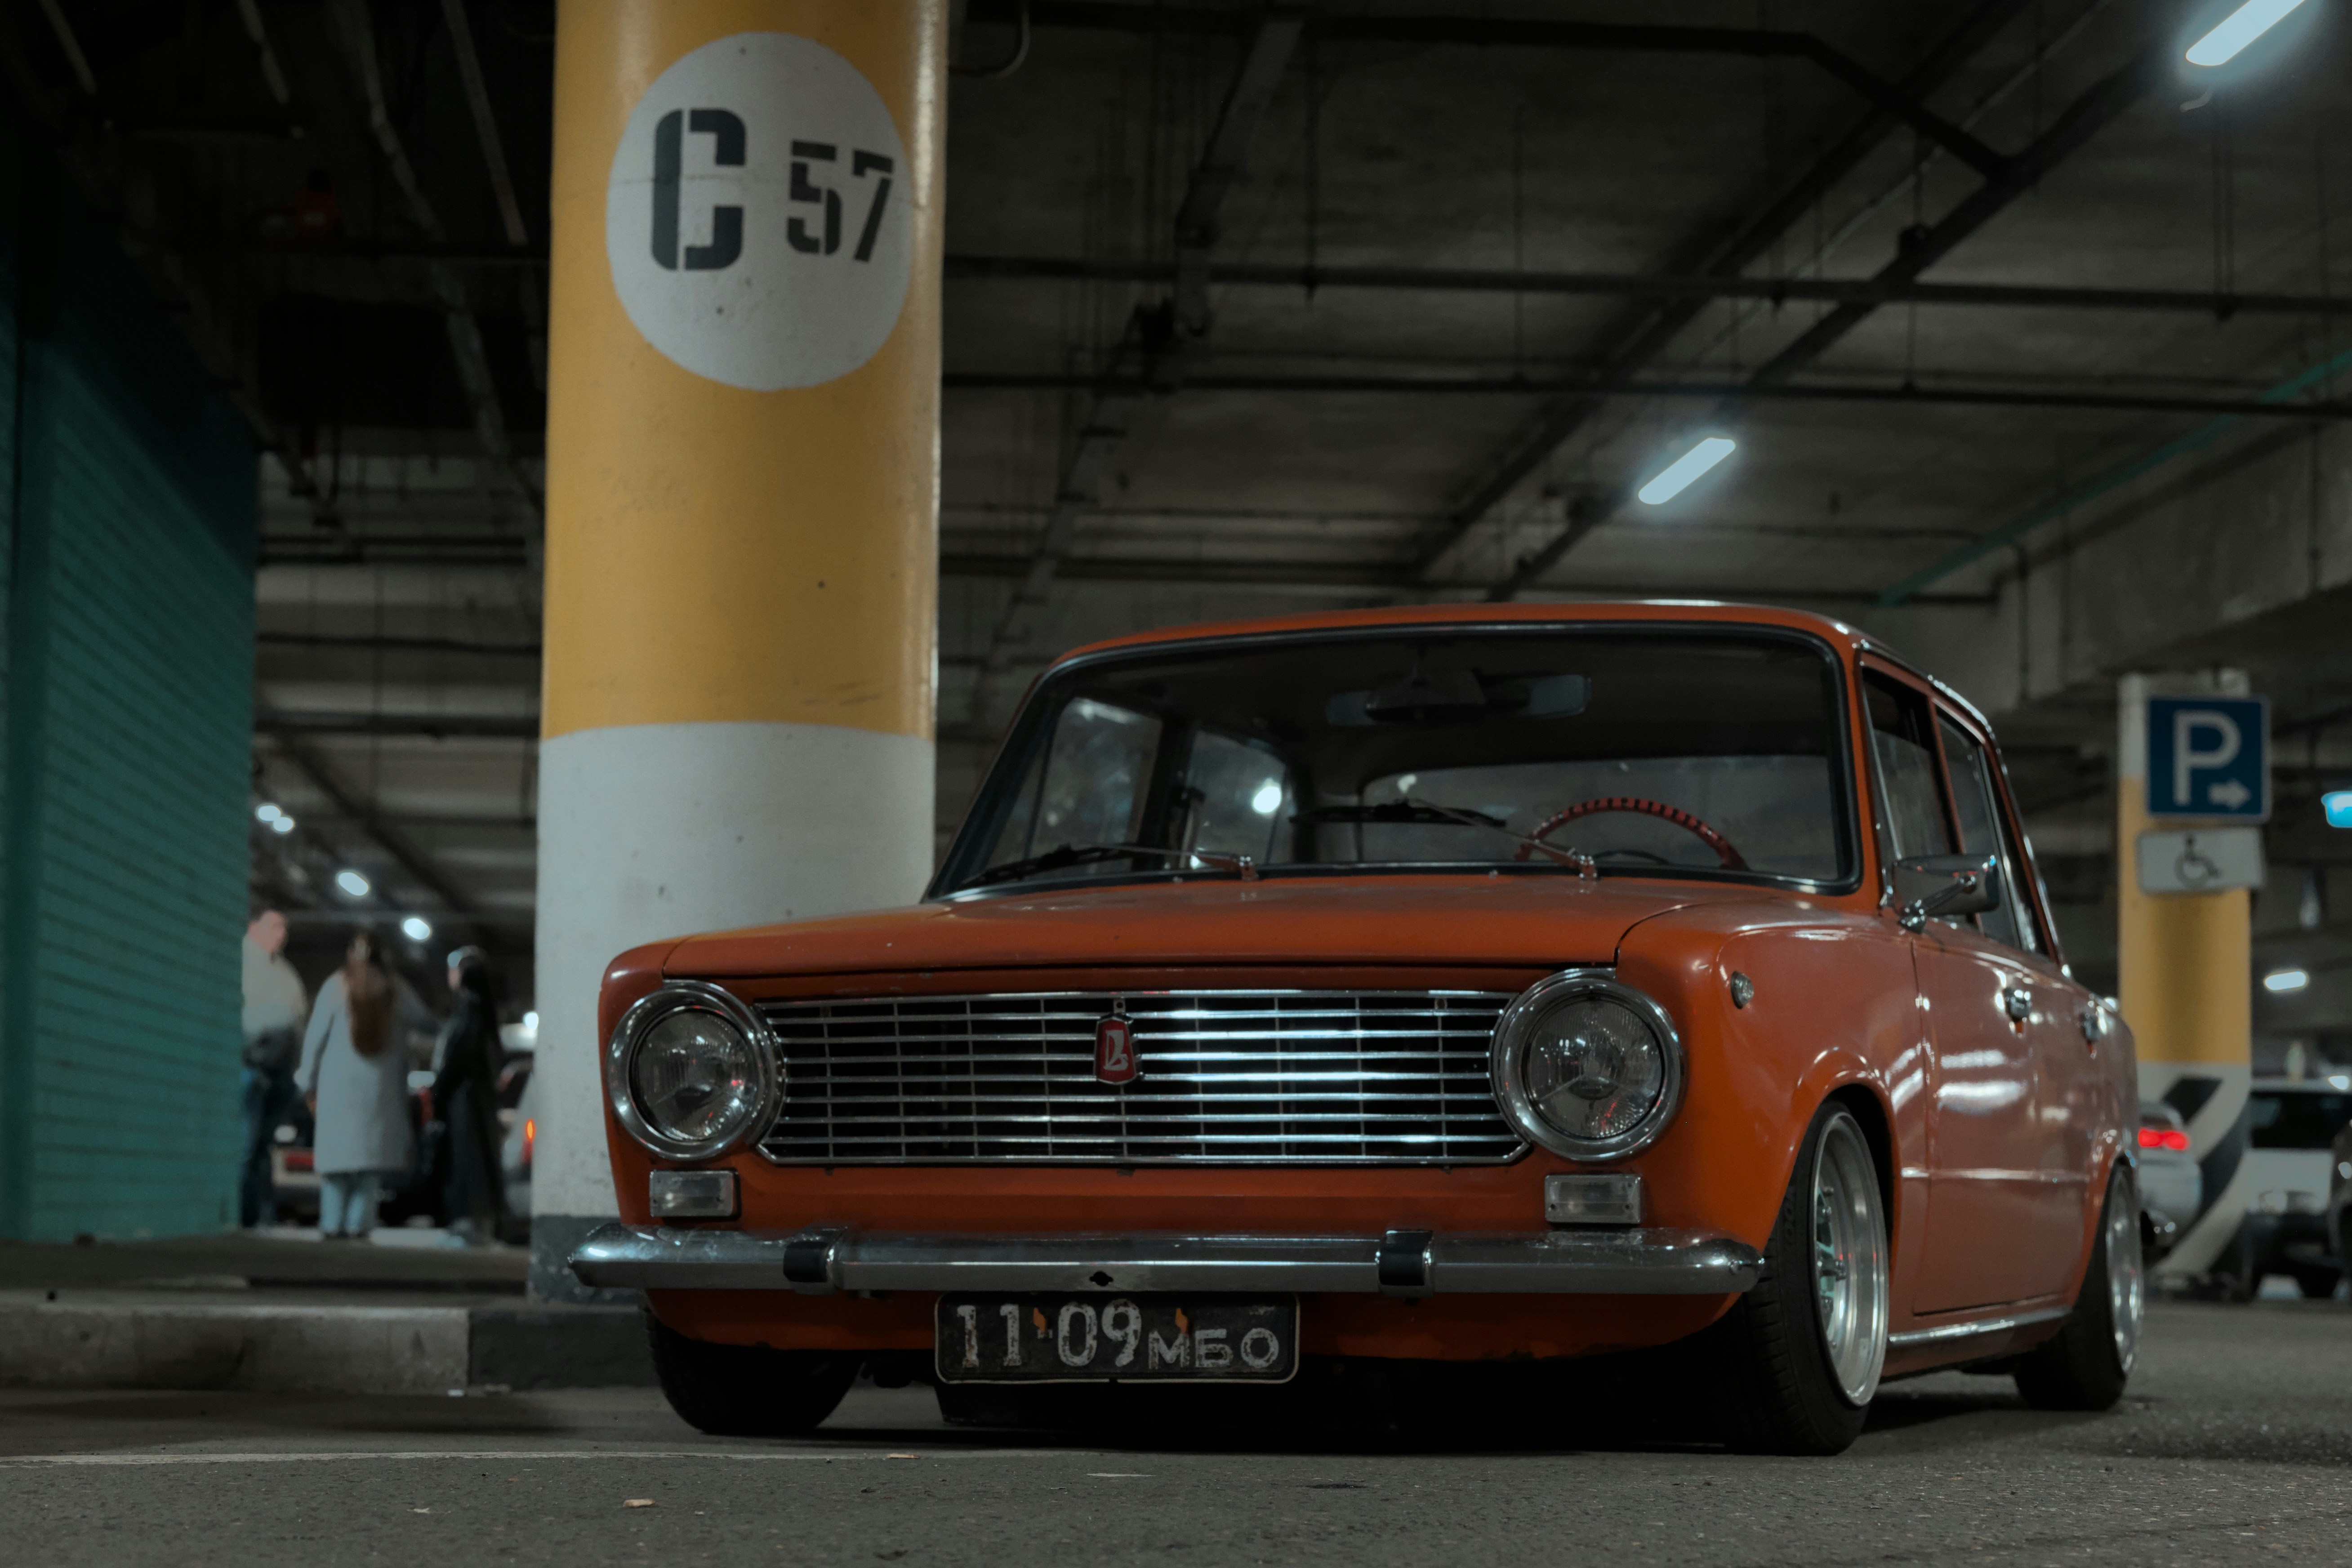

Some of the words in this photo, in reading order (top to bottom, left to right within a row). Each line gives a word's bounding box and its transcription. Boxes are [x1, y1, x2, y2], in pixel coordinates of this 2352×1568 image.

[651, 109, 746, 271] C
[787, 140, 893, 263] 57
[2172, 708, 2243, 806] P
